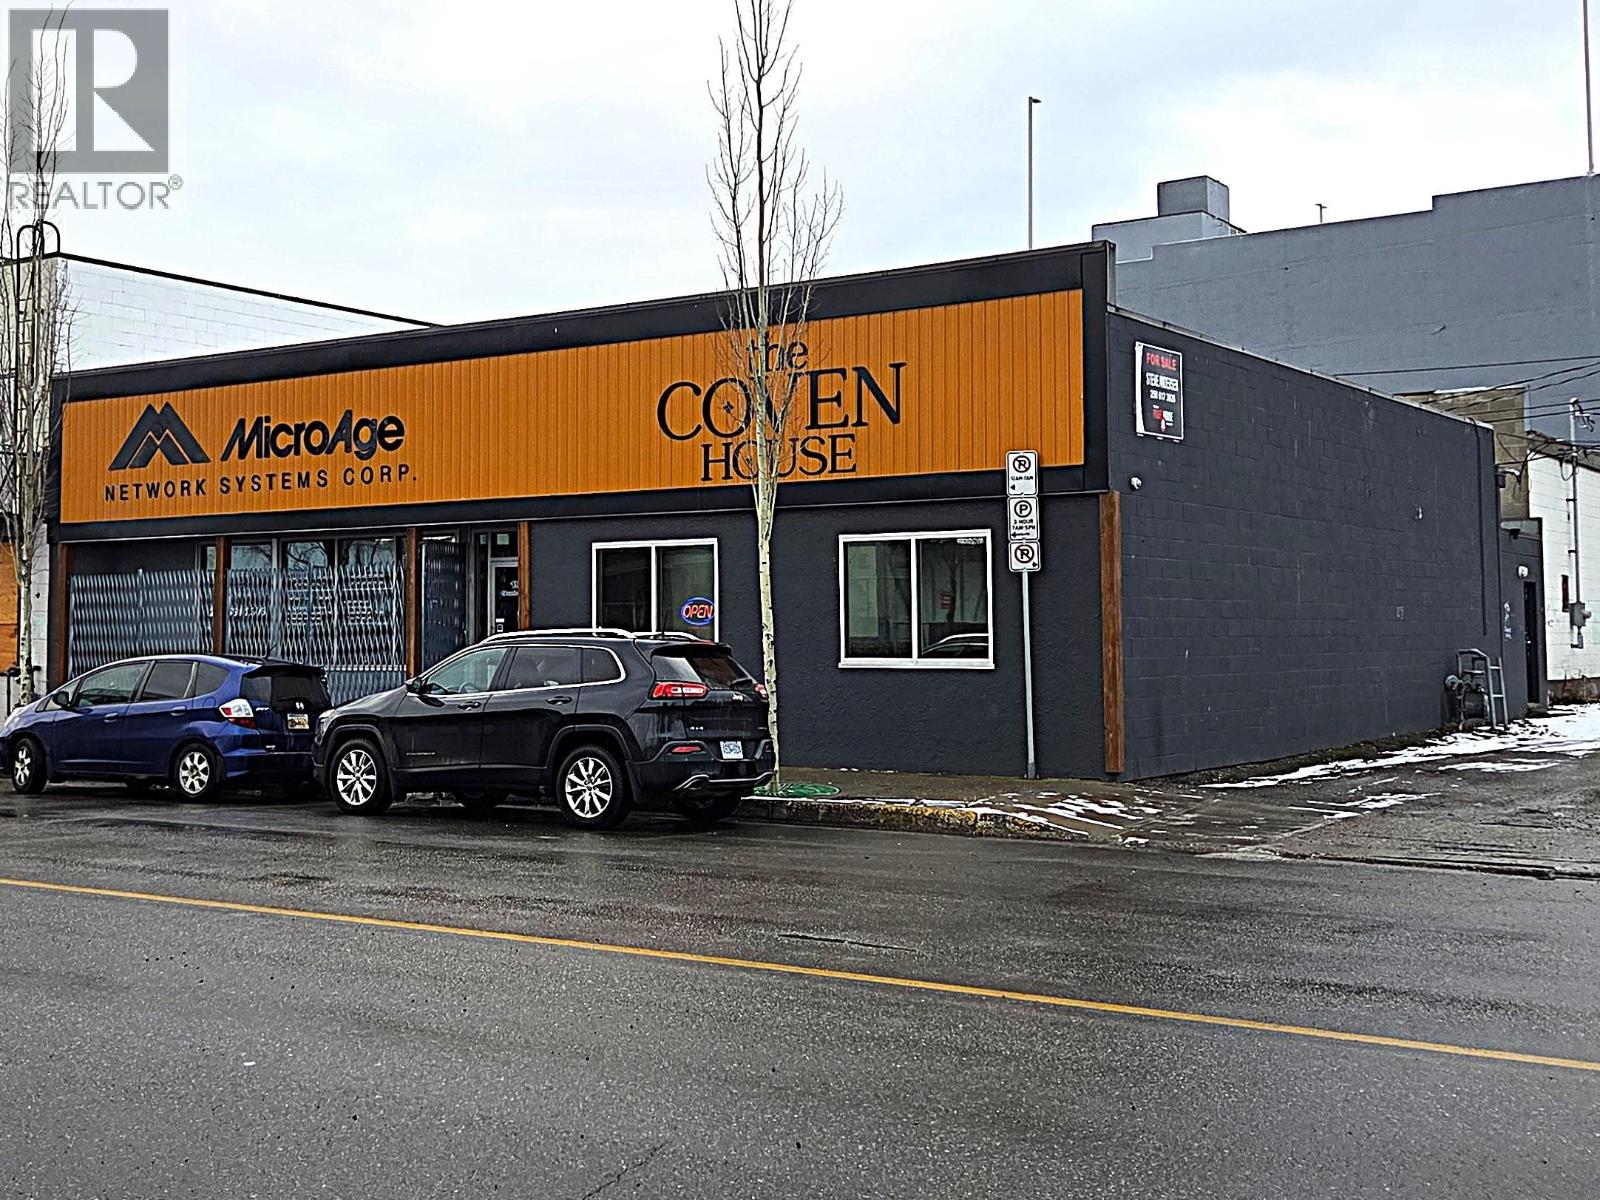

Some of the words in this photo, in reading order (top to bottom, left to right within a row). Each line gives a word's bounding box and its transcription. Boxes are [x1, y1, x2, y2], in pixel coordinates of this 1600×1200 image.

[1147, 353, 1160, 367] FOR
[1161, 356, 1177, 370] SALE
[657, 362, 907, 441] COVEN
[220, 409, 405, 461] MicroAge
[700, 433, 857, 482] HOUSE
[105, 480, 207, 501] NETWORK
[219, 469, 328, 495] SYSTEMS
[343, 463, 417, 486] CORP.
[683, 604, 713, 618] OPEN
